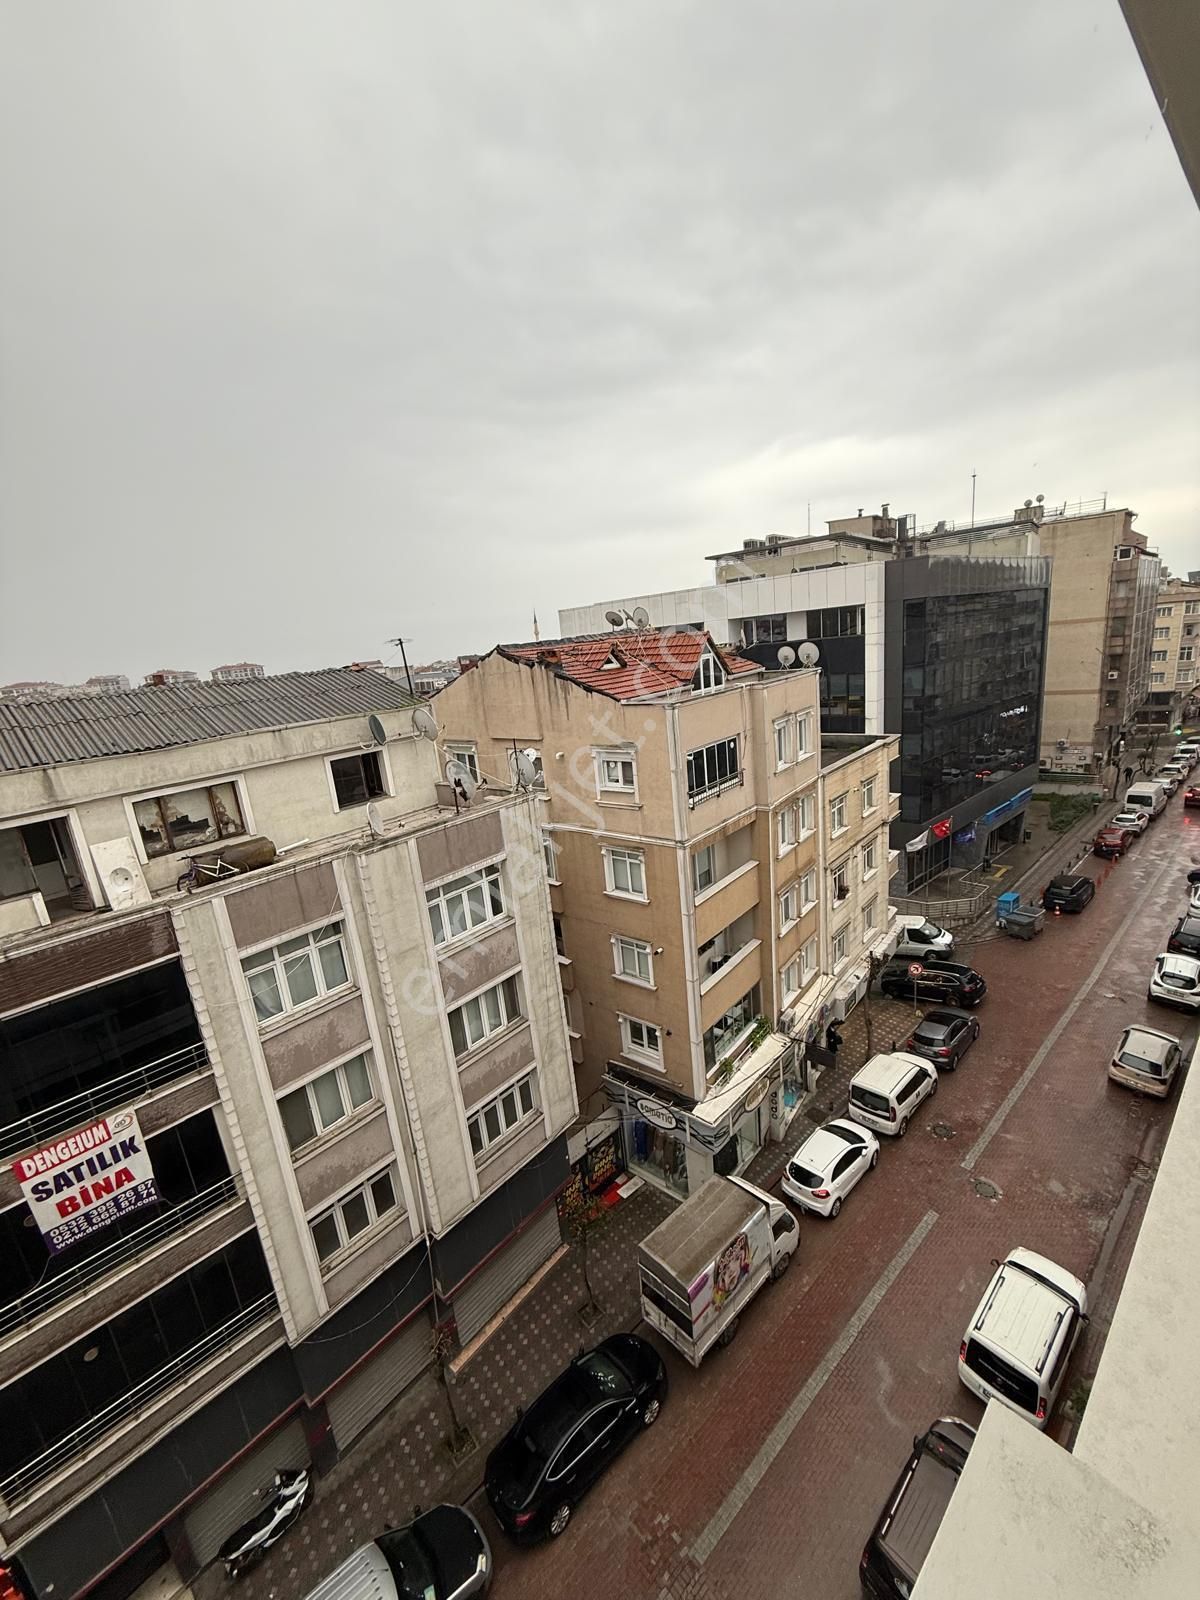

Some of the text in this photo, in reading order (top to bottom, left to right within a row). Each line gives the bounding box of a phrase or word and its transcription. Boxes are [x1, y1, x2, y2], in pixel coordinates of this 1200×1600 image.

[30, 1135, 141, 1202] SATILIK
[56, 1166, 136, 1218] BİNA
[50, 1180, 153, 1237] 0532 395 26 87
[52, 1188, 156, 1244] 0212 665 87 71
